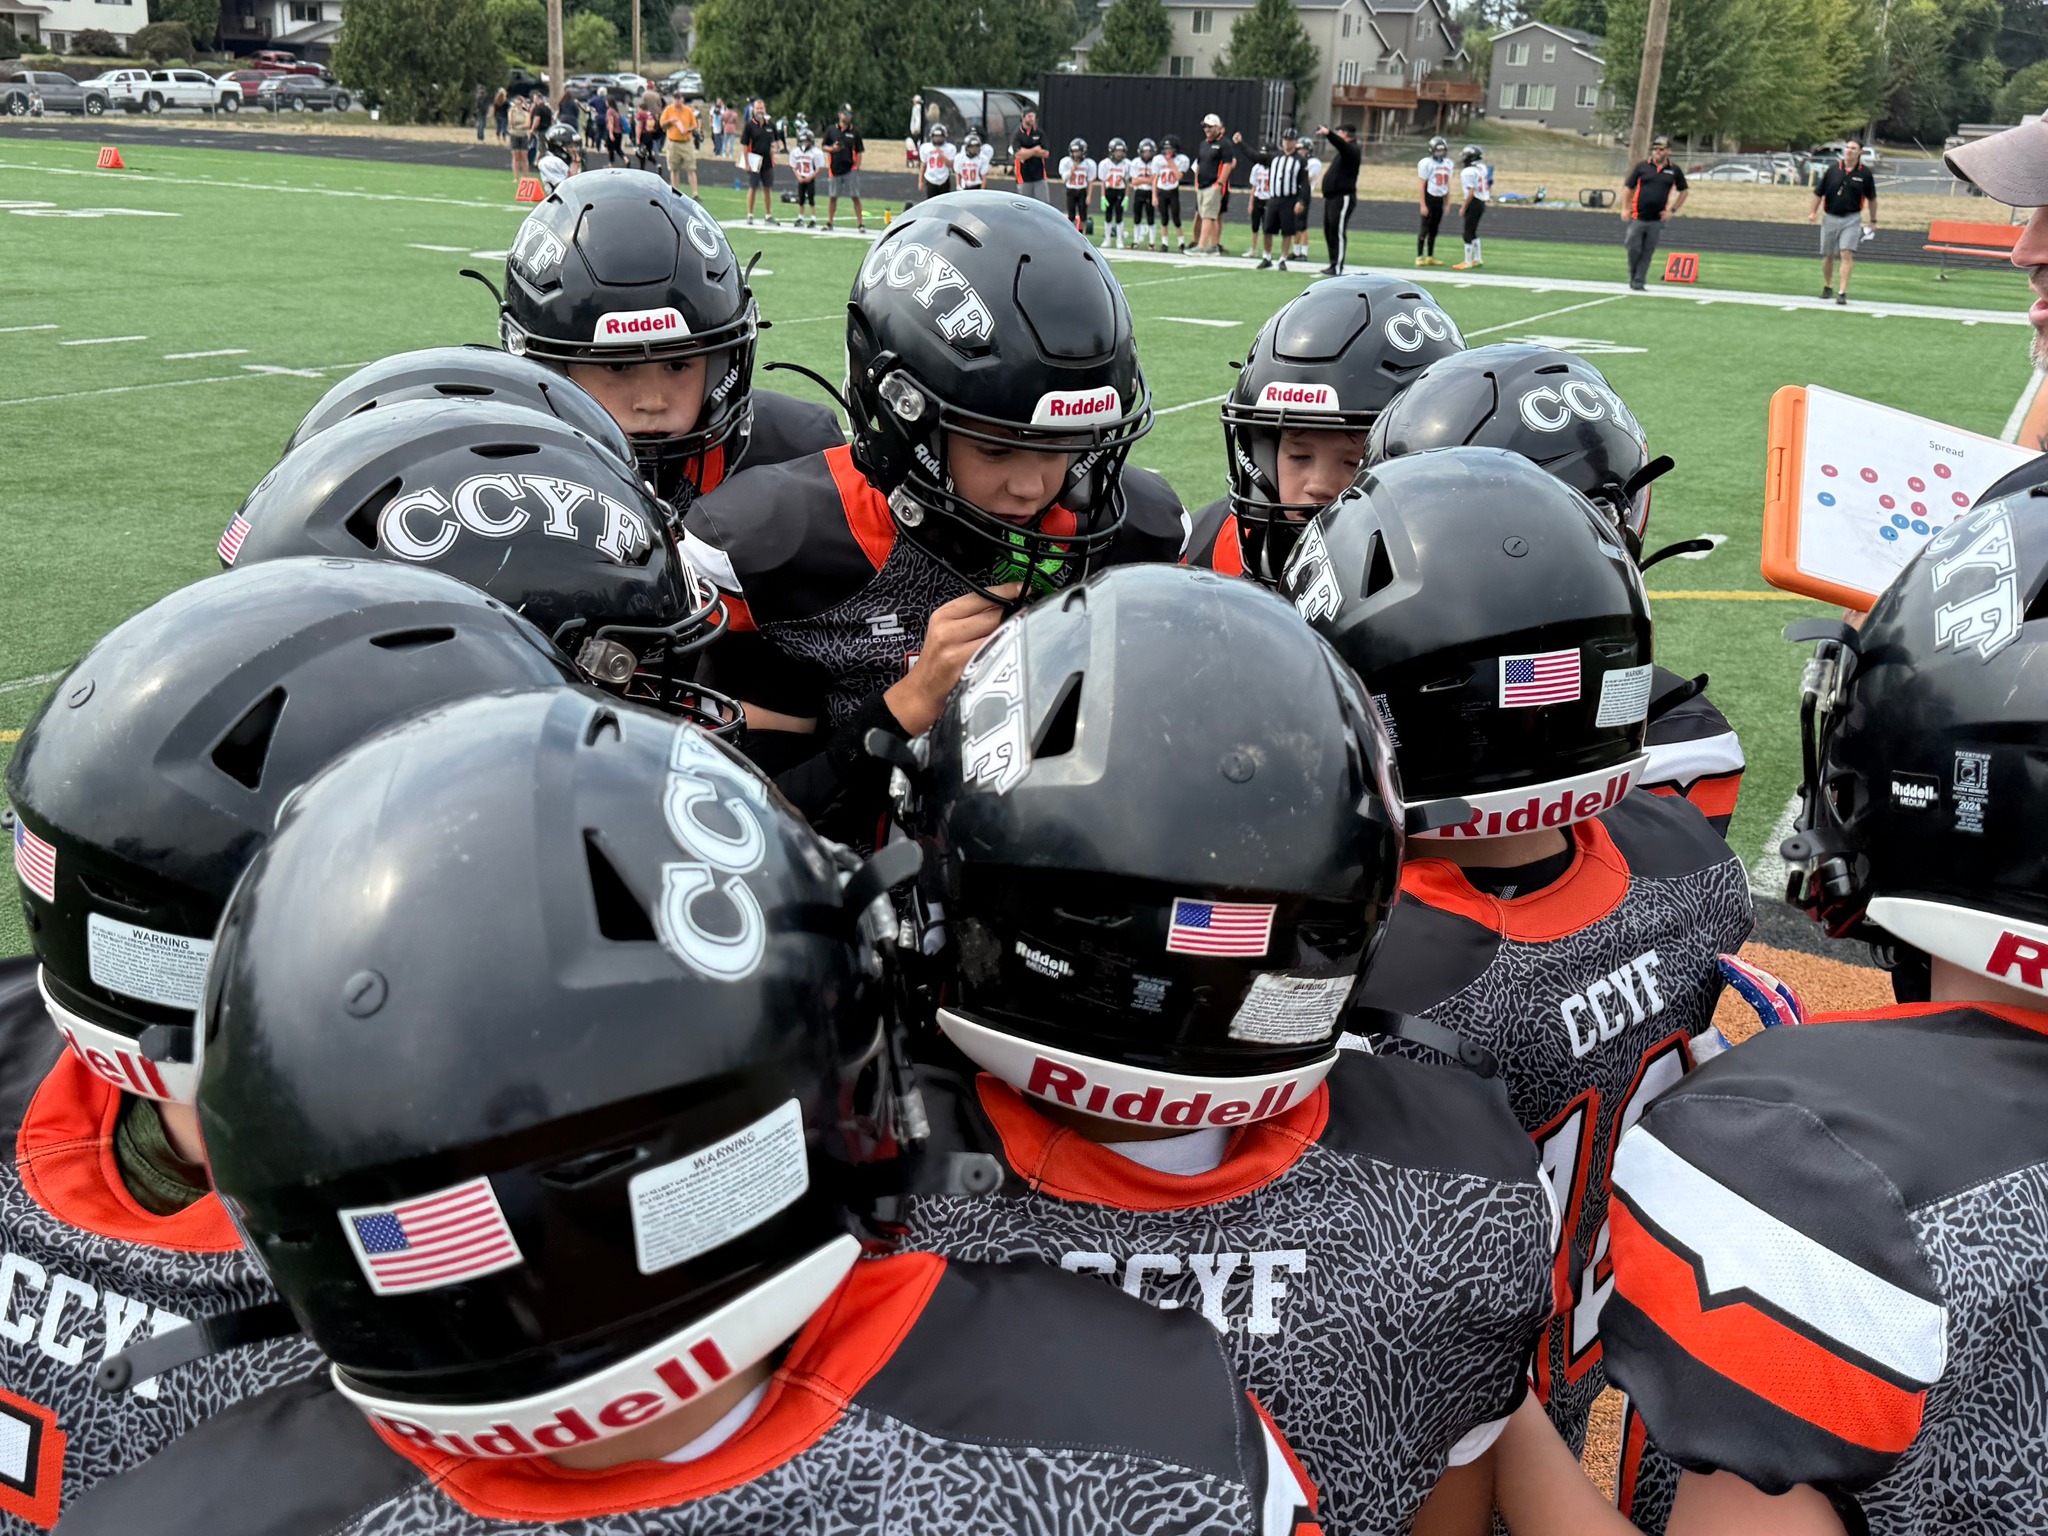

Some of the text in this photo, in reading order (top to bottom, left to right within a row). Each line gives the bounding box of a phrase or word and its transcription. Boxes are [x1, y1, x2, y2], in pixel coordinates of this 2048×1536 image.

[101, 149, 113, 165] 10
[517, 180, 534, 198] 20
[1668, 257, 1693, 279] 40
[862, 240, 995, 341] CCYF
[606, 313, 677, 335] Riddell
[1050, 393, 1116, 417] Riddell
[1266, 386, 1328, 405] Riddell
[1928, 440, 1965, 458] Spread
[379, 472, 649, 567] CCYF
[1891, 781, 1936, 800] Riddell
[1899, 797, 1927, 809] MEDIUM
[1958, 801, 1981, 811] 2024
[133, 929, 190, 949] WARNING
[1015, 941, 1070, 976] Riddell
[1137, 981, 1165, 992] 2024
[1560, 949, 1665, 1059] CCYF
[1027, 1055, 1298, 1127] Riddell
[692, 1131, 756, 1170] WARNING
[373, 1336, 733, 1457] Riddell
